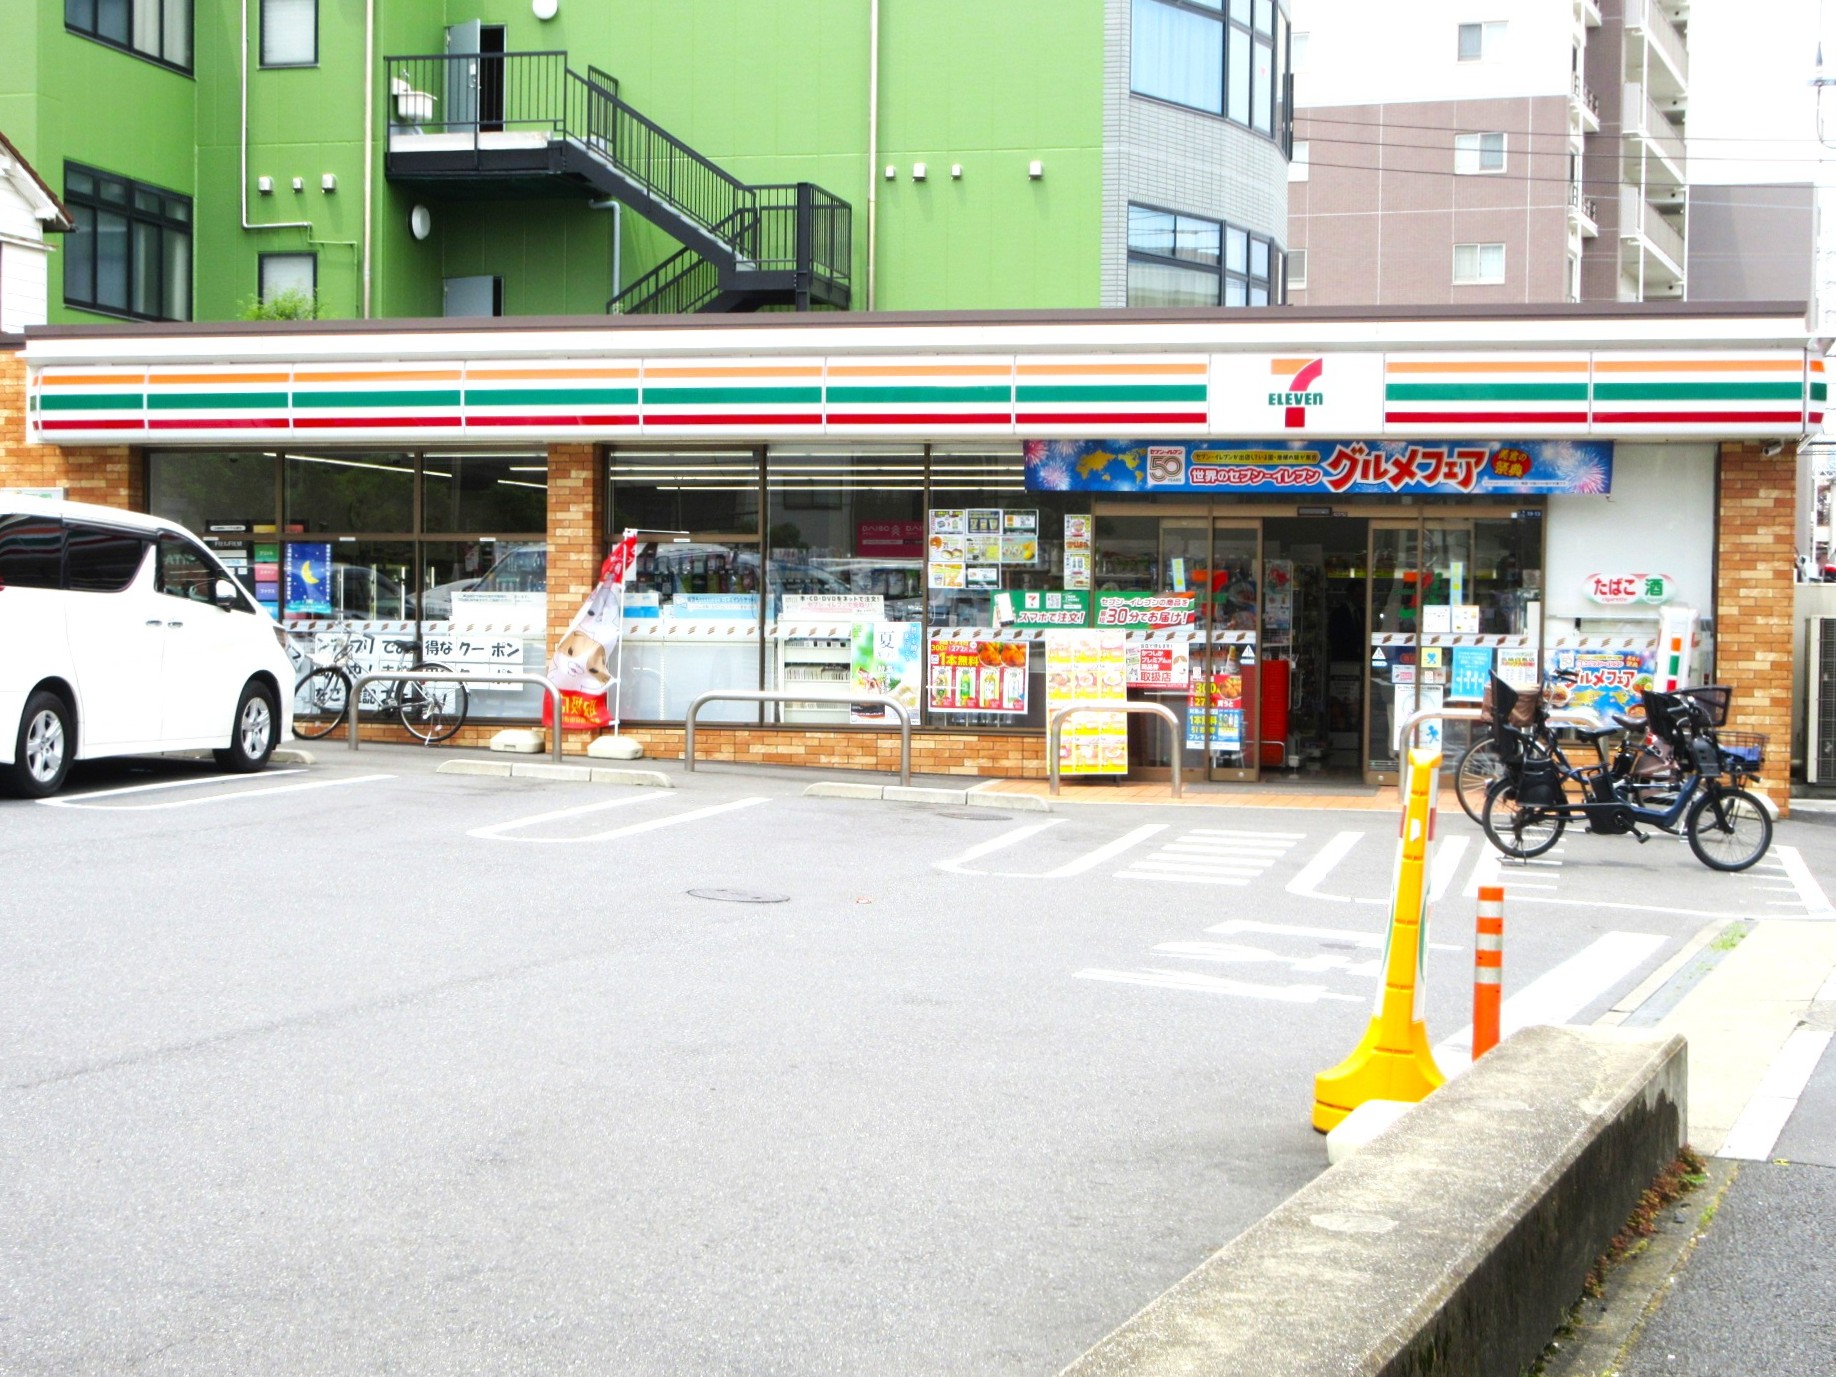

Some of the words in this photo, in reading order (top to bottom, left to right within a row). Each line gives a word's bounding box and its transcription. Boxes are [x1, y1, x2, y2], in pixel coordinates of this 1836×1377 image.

[1327, 444, 1488, 491] グルメフェア
[1594, 578, 1636, 596] たばこ
[1645, 578, 1663, 596] 酒
[1141, 672, 1172, 682] 取扱店
